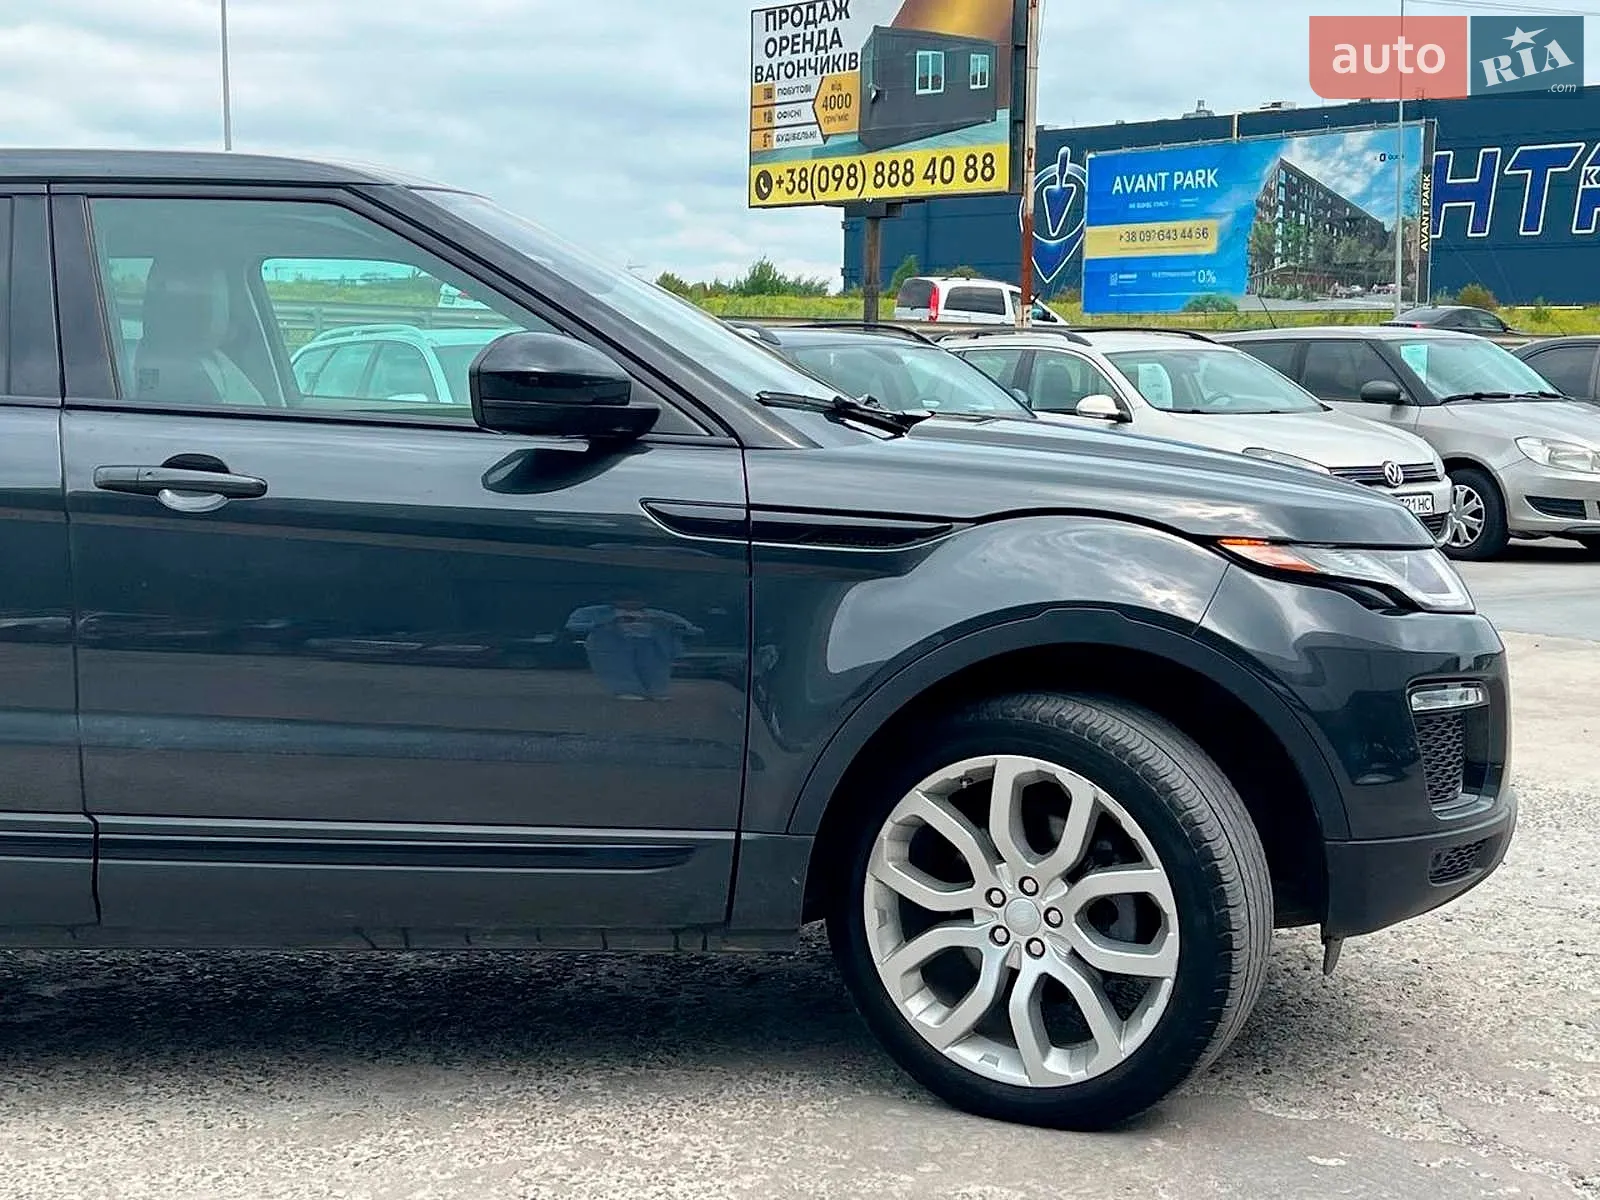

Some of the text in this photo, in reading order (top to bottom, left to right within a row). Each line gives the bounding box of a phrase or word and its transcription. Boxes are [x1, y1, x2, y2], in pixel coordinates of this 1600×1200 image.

[765, 0, 850, 32] ПРОДАЖ
[765, 27, 843, 58] ОРЕНДА
[754, 52, 859, 83] ВАГОНЧИКІВ
[822, 92, 852, 111] 4000
[775, 152, 996, 200] +38(098) 888 40 88
[1112, 168, 1219, 195] AVANT PARK
[1420, 174, 1431, 252] AVANT PARK
